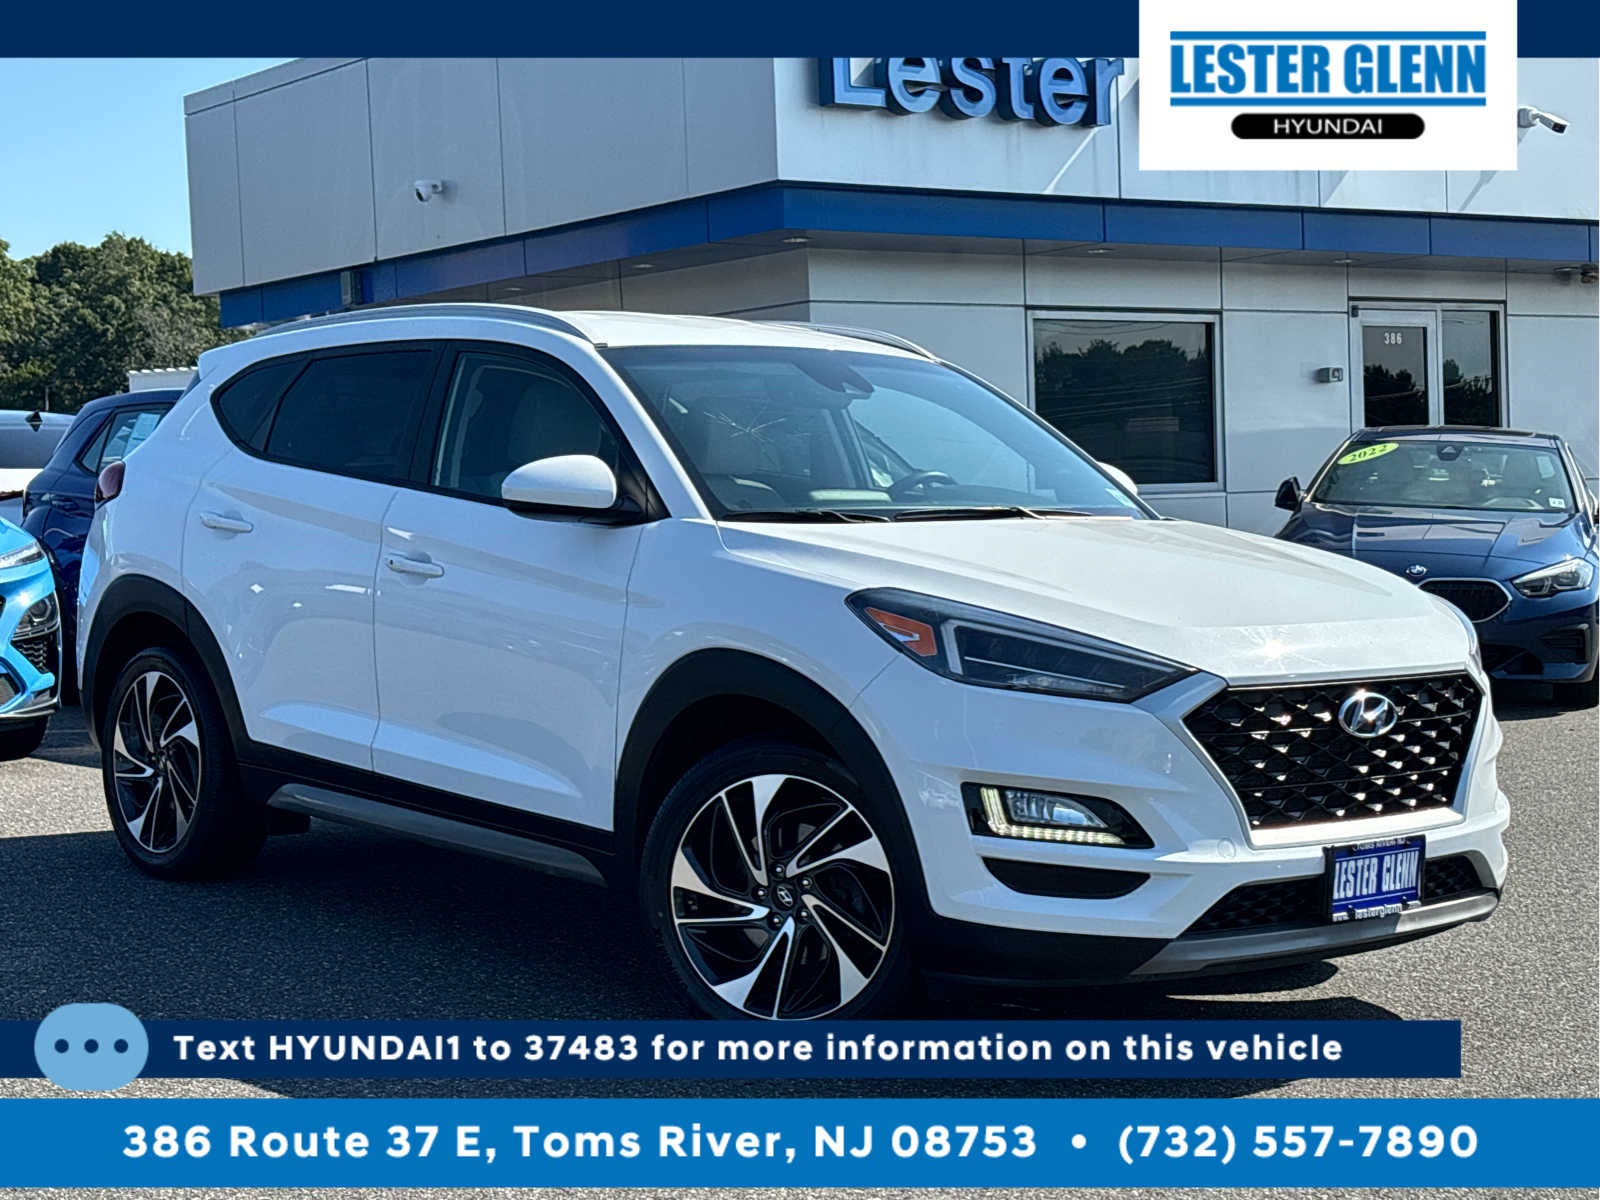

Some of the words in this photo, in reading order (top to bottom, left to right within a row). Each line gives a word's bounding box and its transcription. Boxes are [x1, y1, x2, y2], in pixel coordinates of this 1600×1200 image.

[828, 57, 1124, 127] Lester
[1384, 332, 1402, 344] 386
[1350, 444, 1387, 461] 2022
[1333, 857, 1378, 900] LESTER
[1381, 851, 1419, 892] GLENN
